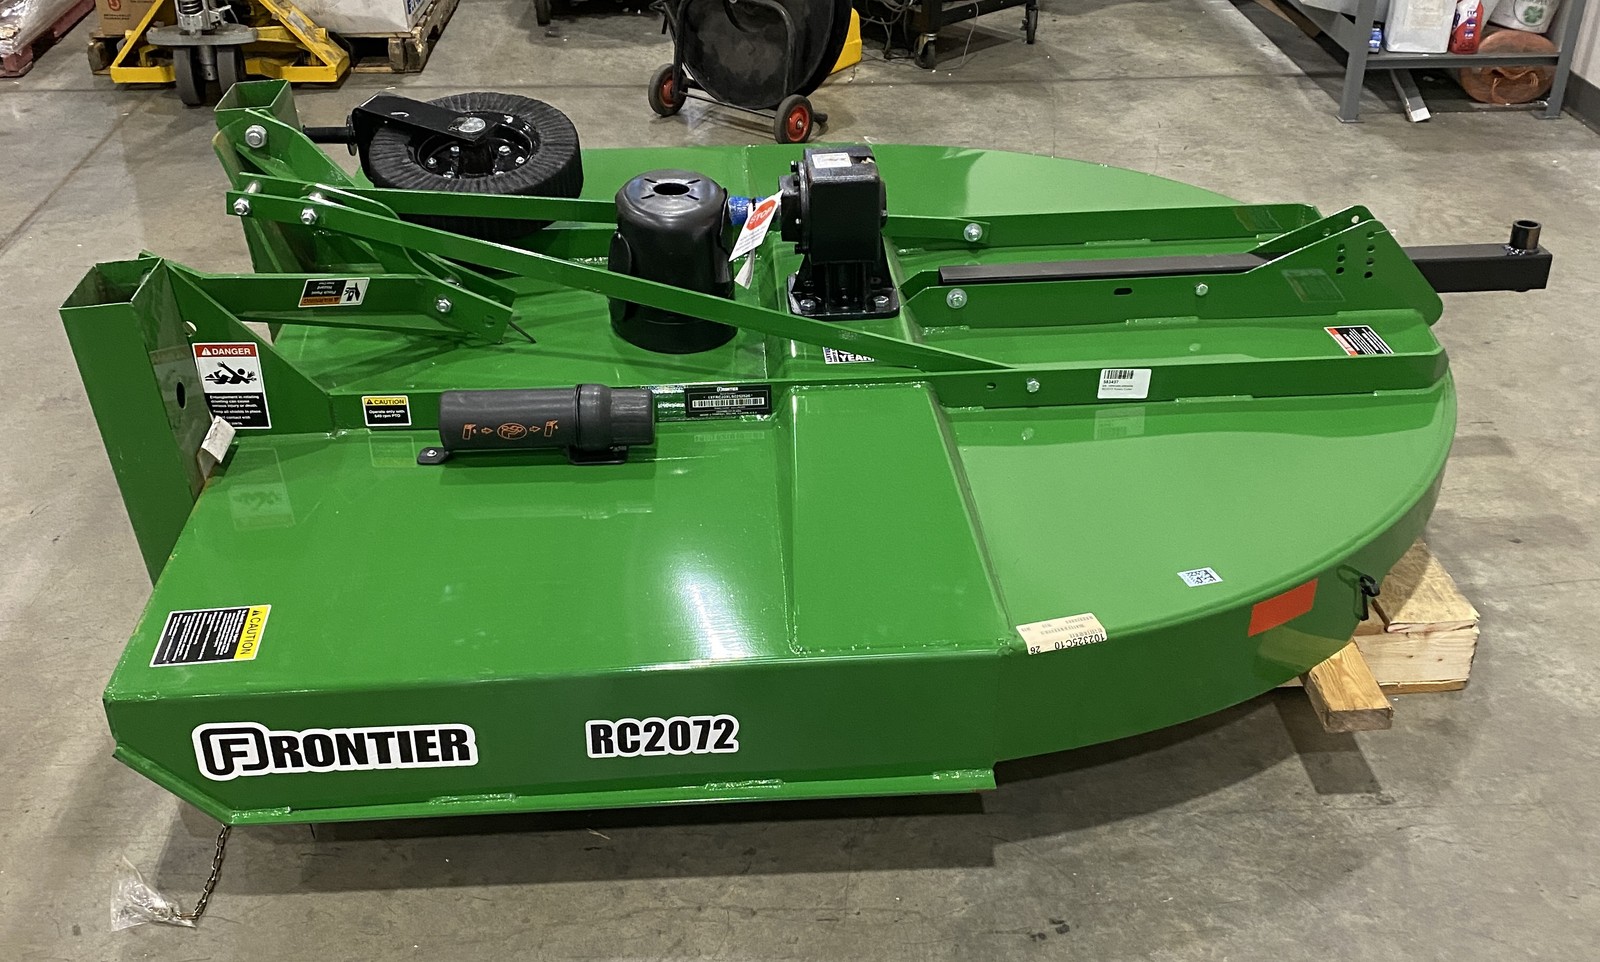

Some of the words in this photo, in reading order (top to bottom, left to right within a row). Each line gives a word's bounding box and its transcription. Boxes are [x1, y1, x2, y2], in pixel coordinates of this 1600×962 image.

[750, 205, 774, 224] STOP
[212, 348, 251, 356] DANGER
[240, 617, 260, 655] CAUTION
[1055, 633, 1105, 650] 102325C10
[1030, 646, 1041, 655] 26
[200, 727, 471, 776] FRONTIER
[591, 718, 735, 756] RC2072
